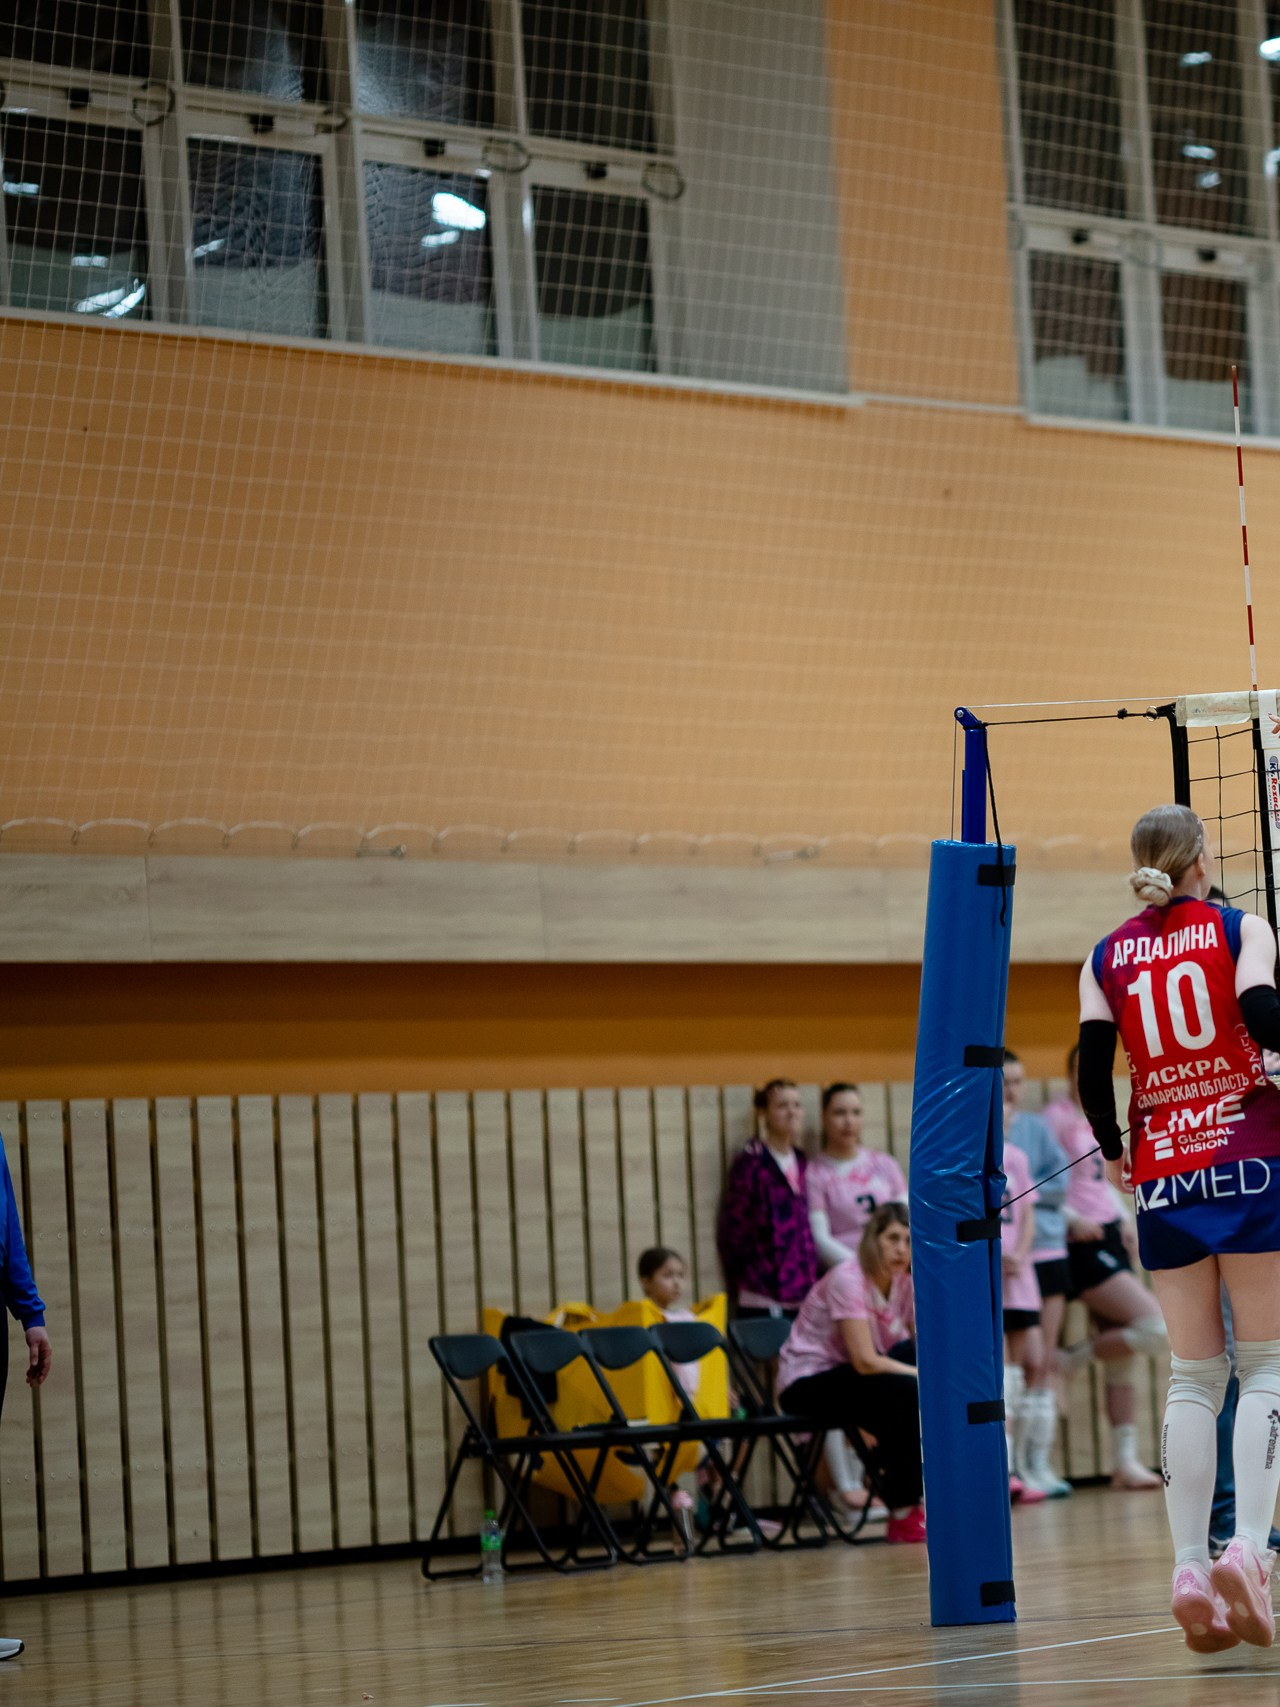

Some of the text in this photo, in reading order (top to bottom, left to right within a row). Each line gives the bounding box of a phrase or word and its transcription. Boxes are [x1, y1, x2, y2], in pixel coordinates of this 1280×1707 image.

[1112, 922, 1218, 969] АРДАЛИНА
[1127, 960, 1217, 1059] 10
[1138, 1073, 1250, 1109] САМАРСКАЯ ОБЛАСТЬ
[1178, 1127, 1236, 1145] GLOBAL
[1179, 1136, 1229, 1155] VISION
[1135, 1157, 1271, 1215] A2MED
